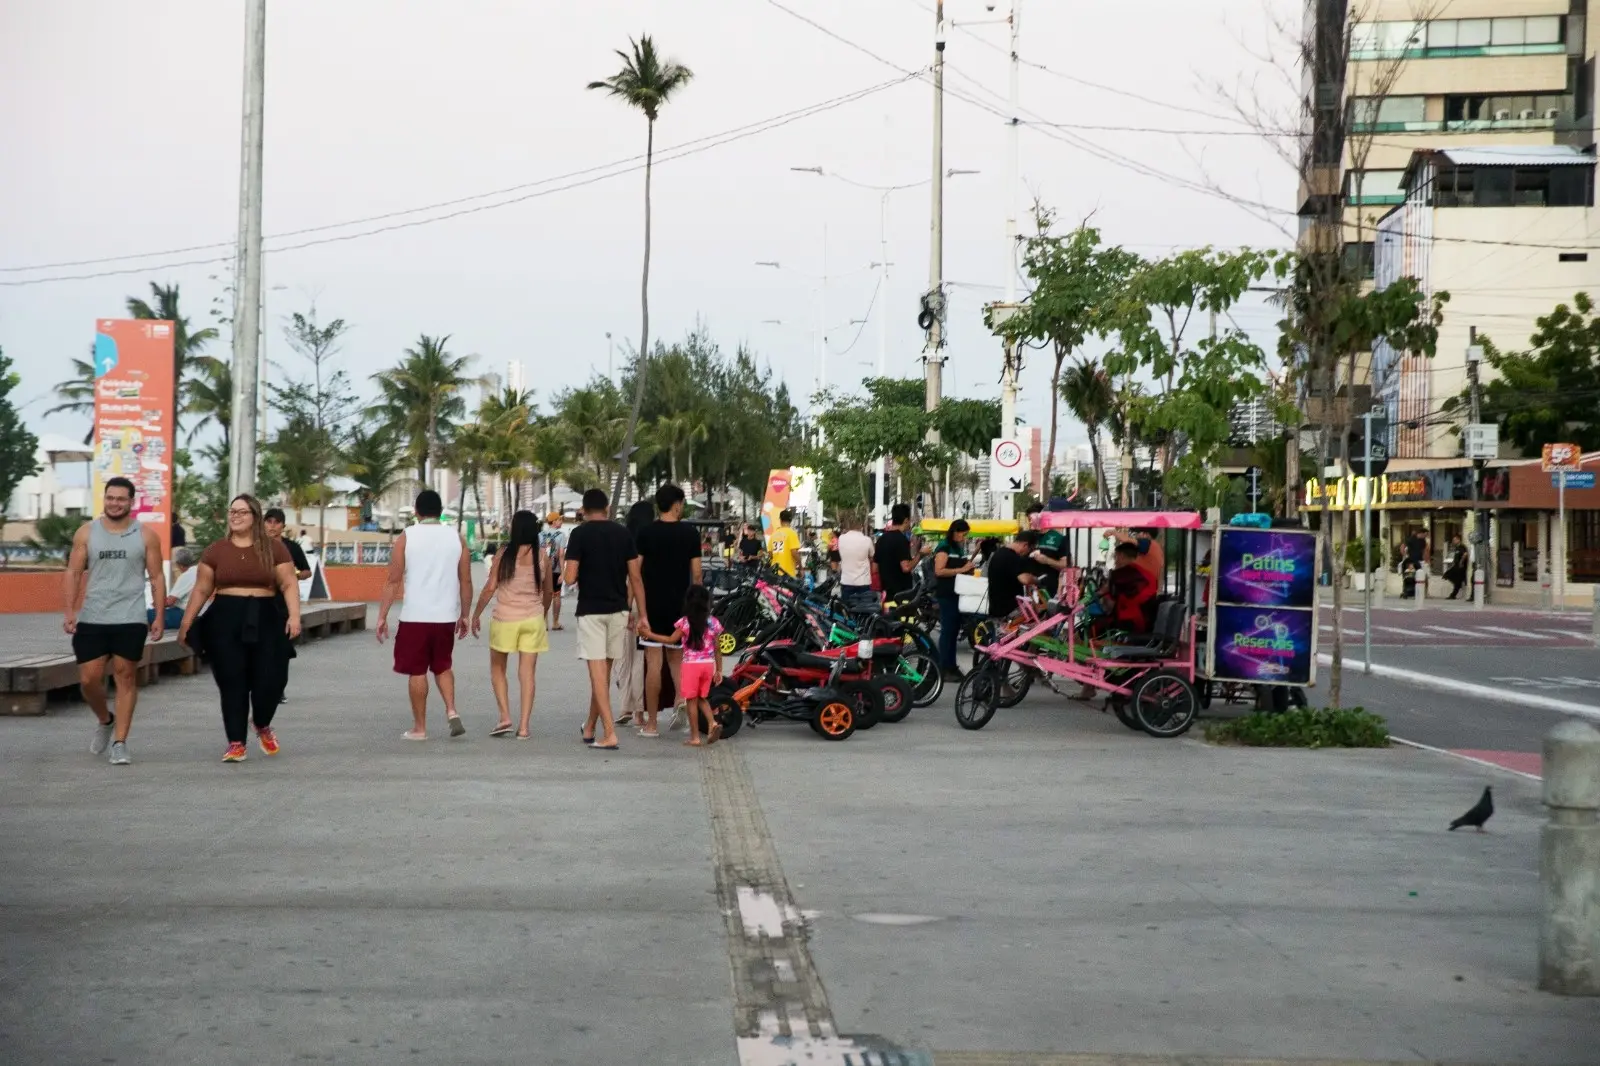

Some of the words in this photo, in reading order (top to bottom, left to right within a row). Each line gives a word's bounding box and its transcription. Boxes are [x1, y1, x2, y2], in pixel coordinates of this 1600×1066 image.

[772, 541, 784, 552] 32
[99, 550, 127, 560] DIESEL
[1241, 553, 1296, 572] Patins
[1233, 632, 1295, 651] Reservas
